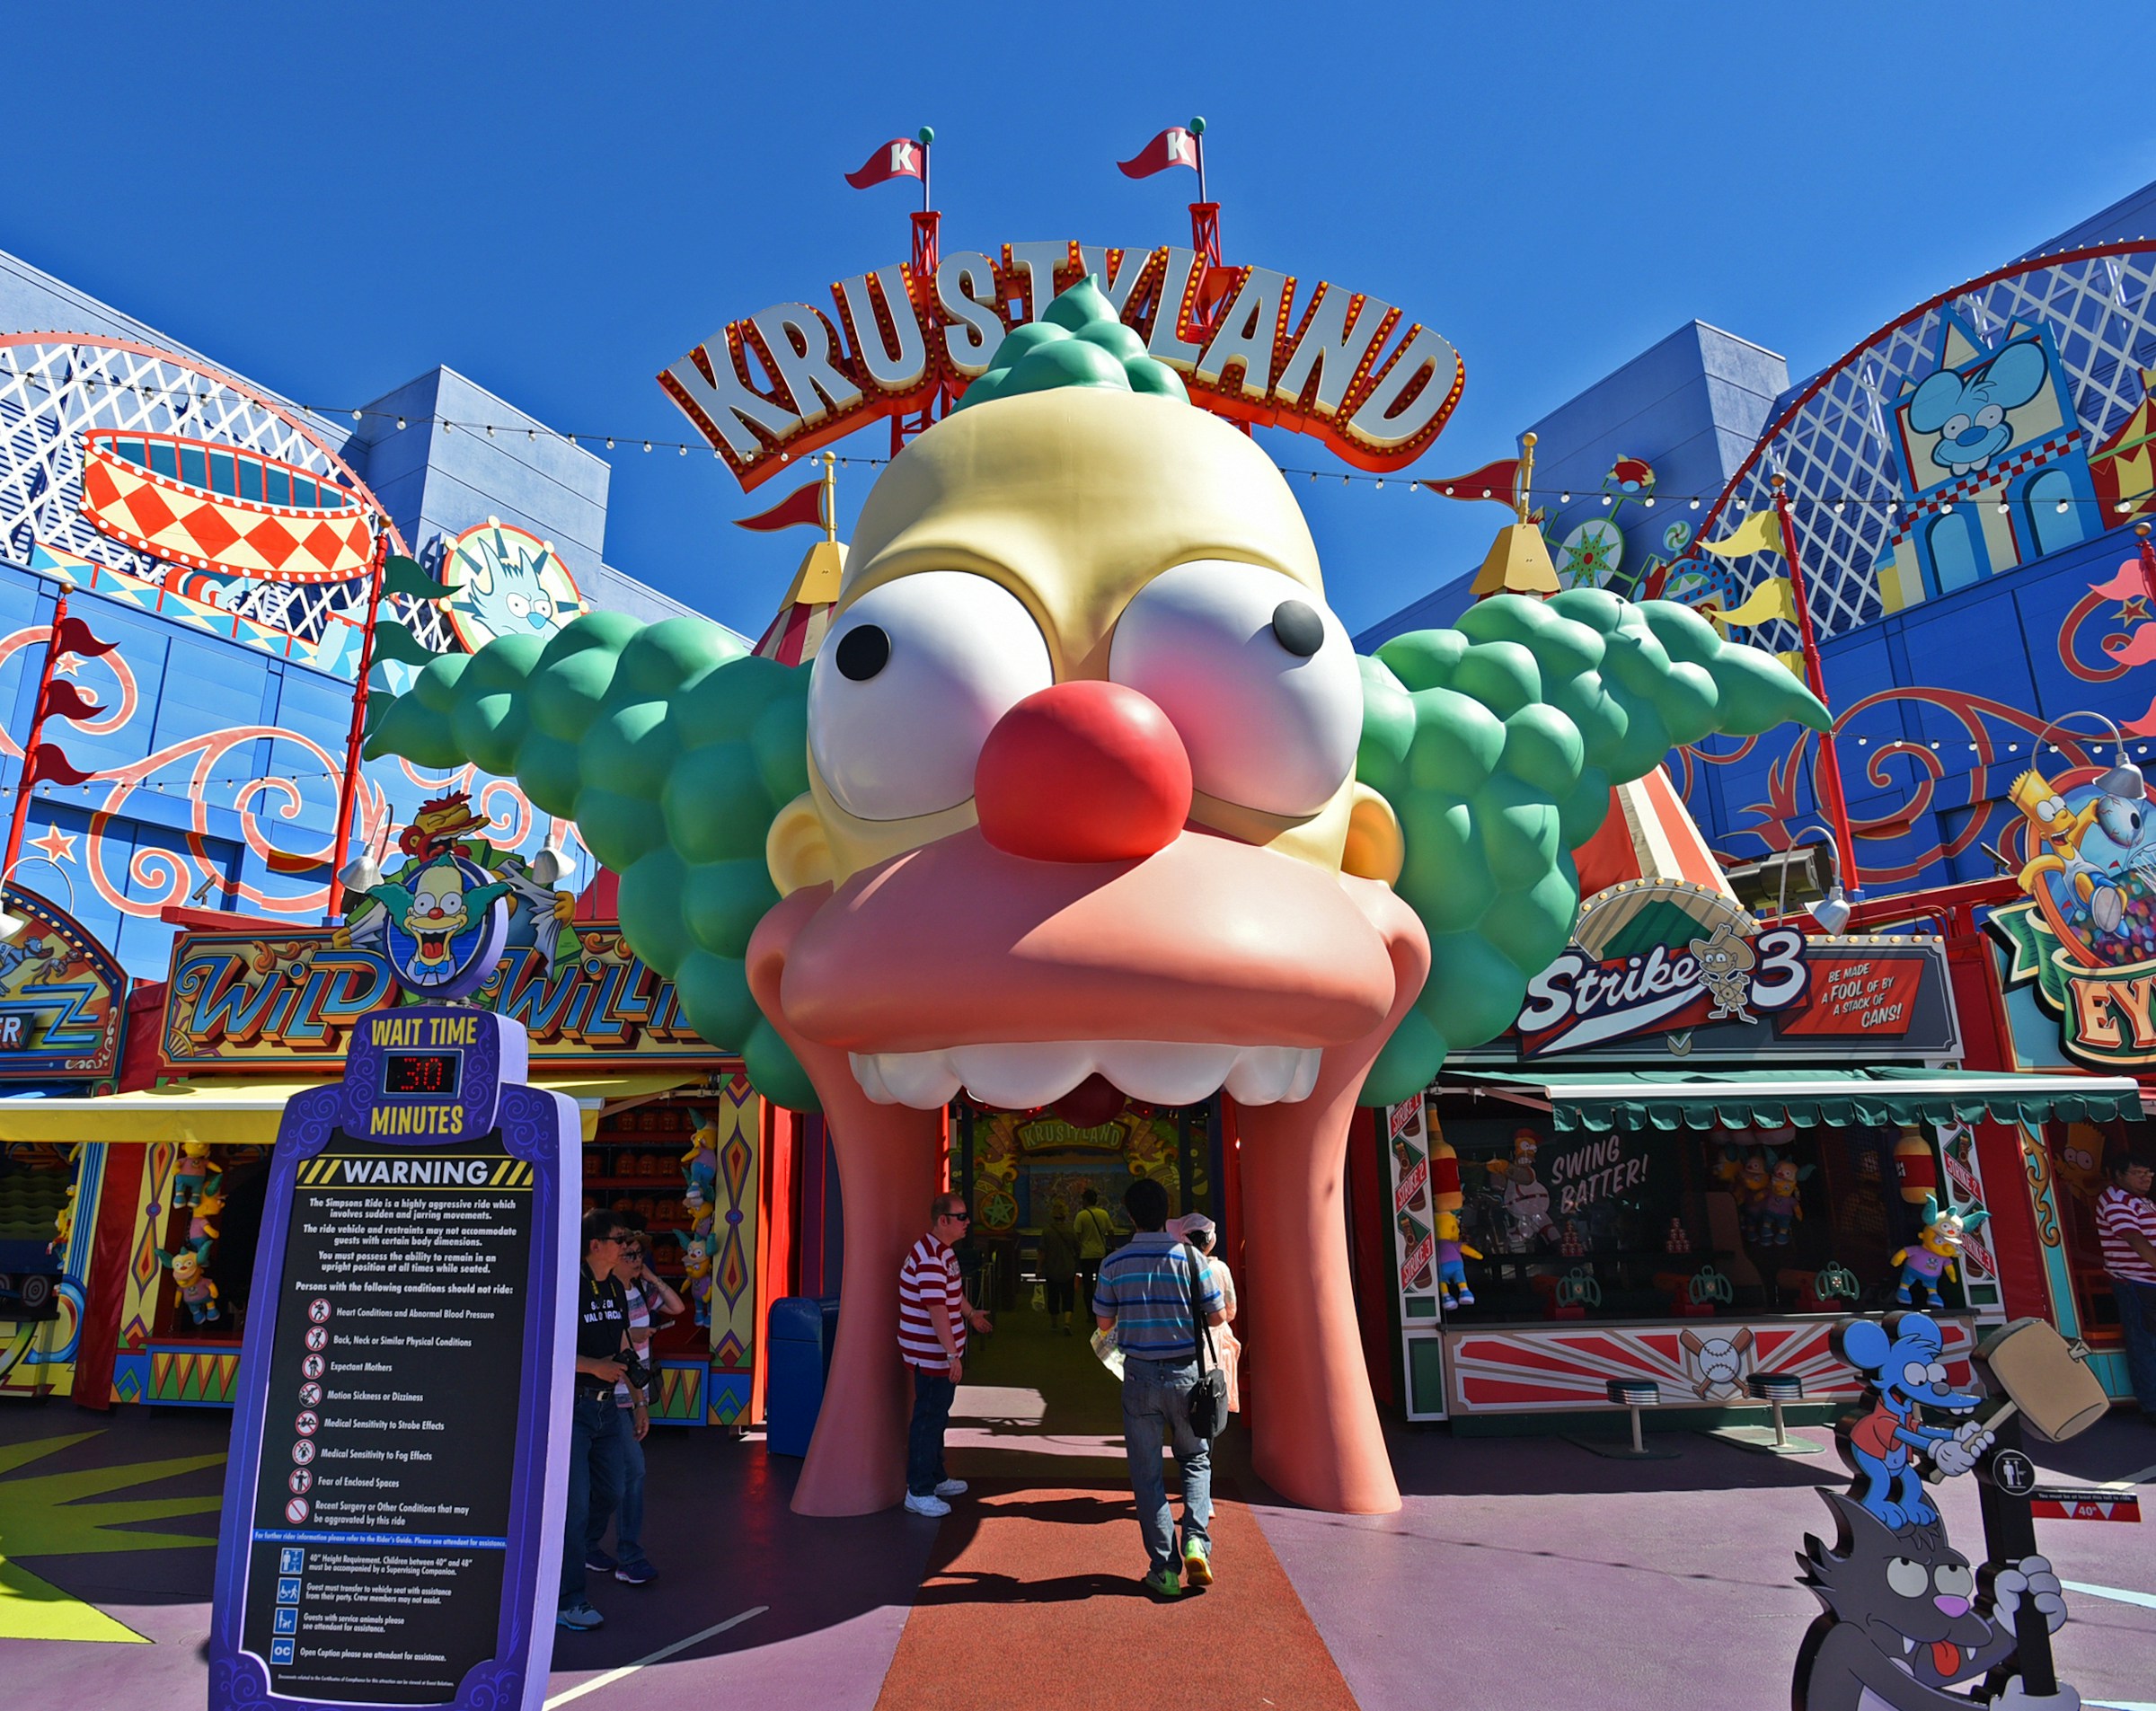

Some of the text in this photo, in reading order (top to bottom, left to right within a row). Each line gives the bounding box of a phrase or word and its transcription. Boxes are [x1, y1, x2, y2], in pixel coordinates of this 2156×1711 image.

[1168, 131, 1191, 162] K
[891, 142, 918, 172] K
[660, 240, 1462, 476] KRUSTYLAND
[1828, 963, 1870, 983] BE MADE
[1515, 931, 1805, 1033] Strike 3
[1821, 976, 1895, 1004] A FOOL OF BY
[1833, 993, 1885, 1016] A STACK OF
[1861, 1003, 1903, 1027] CANS!
[371, 1017, 478, 1046] WAIT TIME
[401, 1058, 442, 1090] 30
[369, 1106, 464, 1135] MINUTES
[1392, 1100, 1414, 1133] STRIKE
[1551, 1135, 1621, 1185] SWING
[344, 1160, 489, 1185] WARNING
[1947, 1159, 1979, 1195] STRIKE 2
[1398, 1167, 1426, 1206] STRIKE 2
[1560, 1154, 1649, 1213] BATTER!
[309, 1198, 323, 1206] The
[325, 1198, 363, 1210] Simpsons
[365, 1198, 383, 1207] Ride
[384, 1198, 392, 1207] is
[401, 1199, 427, 1210] highly
[428, 1199, 472, 1211] aggressive
[473, 1199, 490, 1208] ride
[492, 1200, 516, 1208] which
[330, 1208, 492, 1221] involves sudden and jarring movements.
[303, 1224, 517, 1237] The ride vehicle and restraints may not accommodate
[333, 1235, 482, 1248] guests with certain body dimensions.
[318, 1251, 332, 1259] You
[334, 1251, 355, 1260] must
[356, 1254, 387, 1263] possess
[389, 1252, 402, 1260] the
[404, 1252, 431, 1263] ability
[433, 1252, 442, 1261] to
[444, 1252, 473, 1261] remain
[475, 1253, 483, 1261] in
[1404, 1240, 1431, 1284] STRIKE 3
[321, 1262, 490, 1274] upright position at all times while seated.
[296, 1281, 513, 1294] Persons with the following conditions should not ride:
[336, 1307, 495, 1319] Heart Conditions and Abnormal Blood Pressure
[584, 1312, 598, 1323] VAL
[333, 1335, 352, 1346] Back,
[353, 1335, 370, 1344] Neck
[380, 1336, 404, 1345] Similar
[405, 1336, 434, 1348] Physical
[435, 1336, 472, 1346] Conditions
[330, 1361, 393, 1372] Expectant Mothers
[327, 1389, 351, 1399] Motion
[352, 1390, 381, 1399] Sickness
[392, 1391, 423, 1400] Dizziness
[323, 1418, 445, 1431] Medical Sensitivity to Strobe Effects
[321, 1448, 432, 1462] Medical Sensitivity to Fog Effects
[318, 1476, 399, 1490] Fear of Enclosed Spaces
[315, 1500, 339, 1509] Recent
[340, 1501, 367, 1513] Surgery
[376, 1502, 397, 1511] Other
[398, 1503, 436, 1513] Conditions
[437, 1504, 452, 1513] that
[453, 1507, 469, 1516] may
[314, 1513, 405, 1527] be aggravated by this ride
[274, 1646, 291, 1656] OC
[299, 1647, 316, 1658] Open
[316, 1648, 340, 1659] Caption
[340, 1649, 361, 1660] please
[374, 1651, 403, 1659] attendant
[403, 1652, 413, 1660] for
[413, 1652, 446, 1661] assistance.
